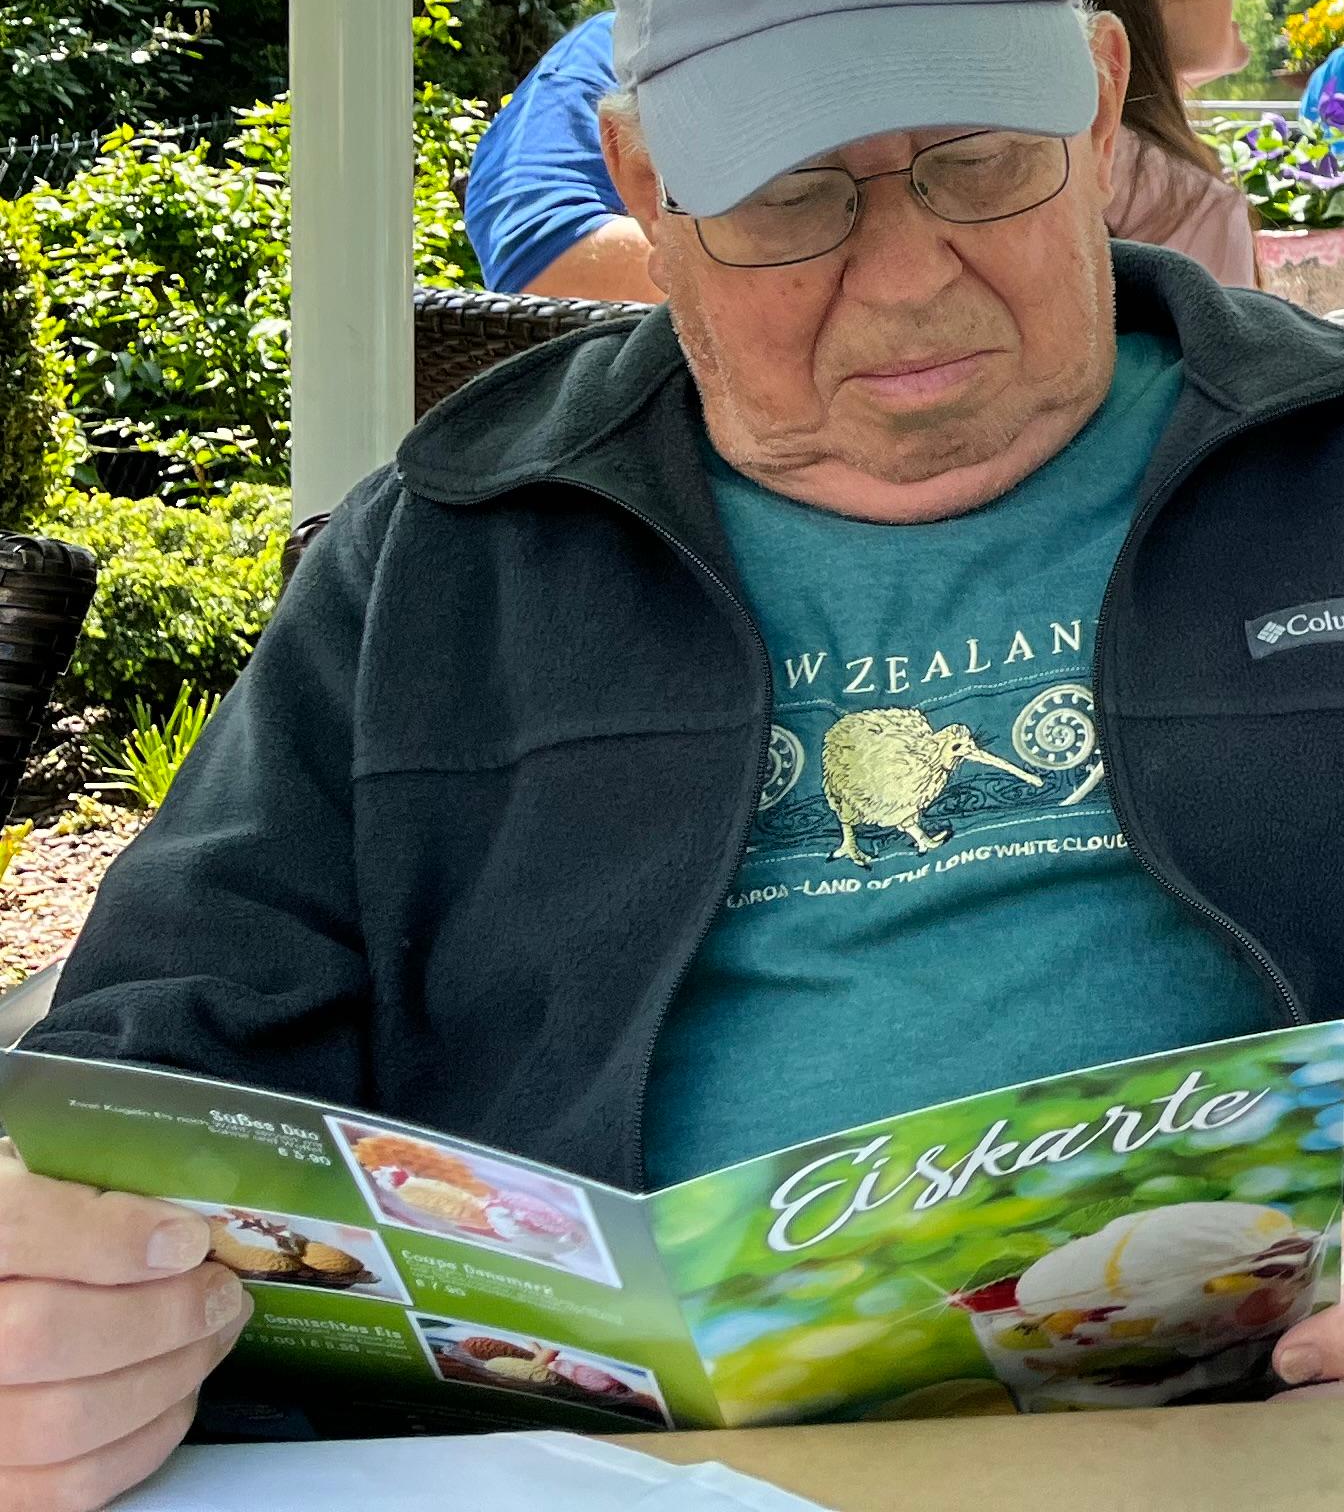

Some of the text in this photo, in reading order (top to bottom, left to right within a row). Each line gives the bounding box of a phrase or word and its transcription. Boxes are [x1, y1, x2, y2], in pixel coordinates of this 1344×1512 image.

[842, 619, 1107, 695] ZEALAN
[935, 845, 993, 873] LONG
[993, 838, 1060, 859] WHITE
[767, 1071, 1271, 1253] Eiskarte
[263, 1313, 403, 1339] Gemischtes Eis
